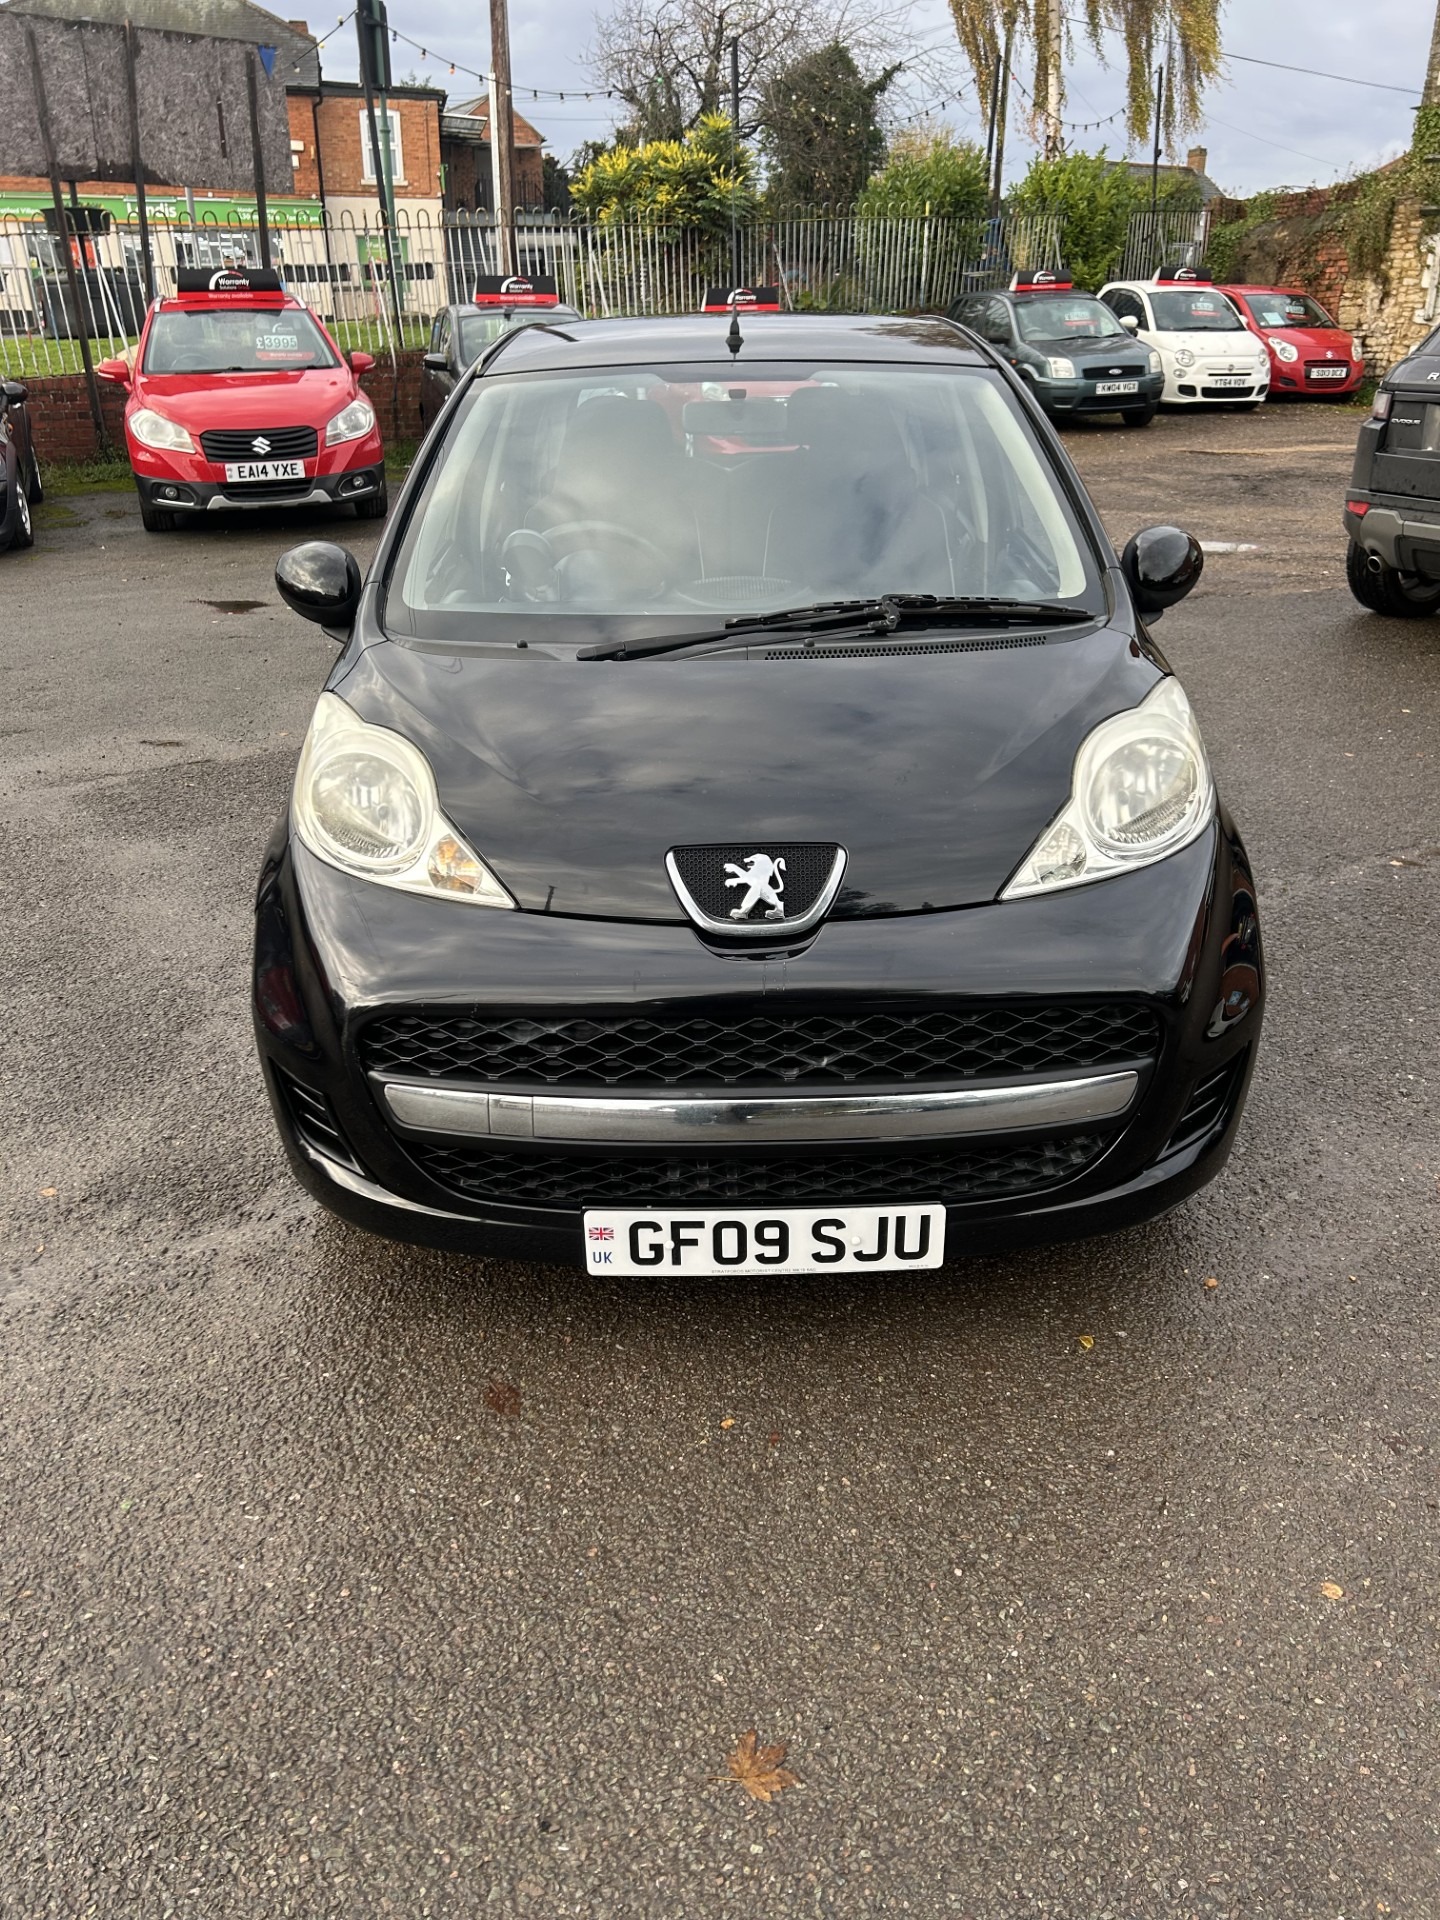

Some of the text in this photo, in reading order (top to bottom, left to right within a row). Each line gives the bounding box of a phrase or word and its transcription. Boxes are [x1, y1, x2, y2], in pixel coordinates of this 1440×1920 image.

[218, 277, 250, 287] Warranty
[256, 336, 297, 349] £3995
[1101, 383, 1120, 392] KW04
[237, 464, 268, 479] EA14
[272, 463, 299, 477] YXE
[628, 1214, 931, 1266] GF09 SJU
[592, 1251, 613, 1264] UK
